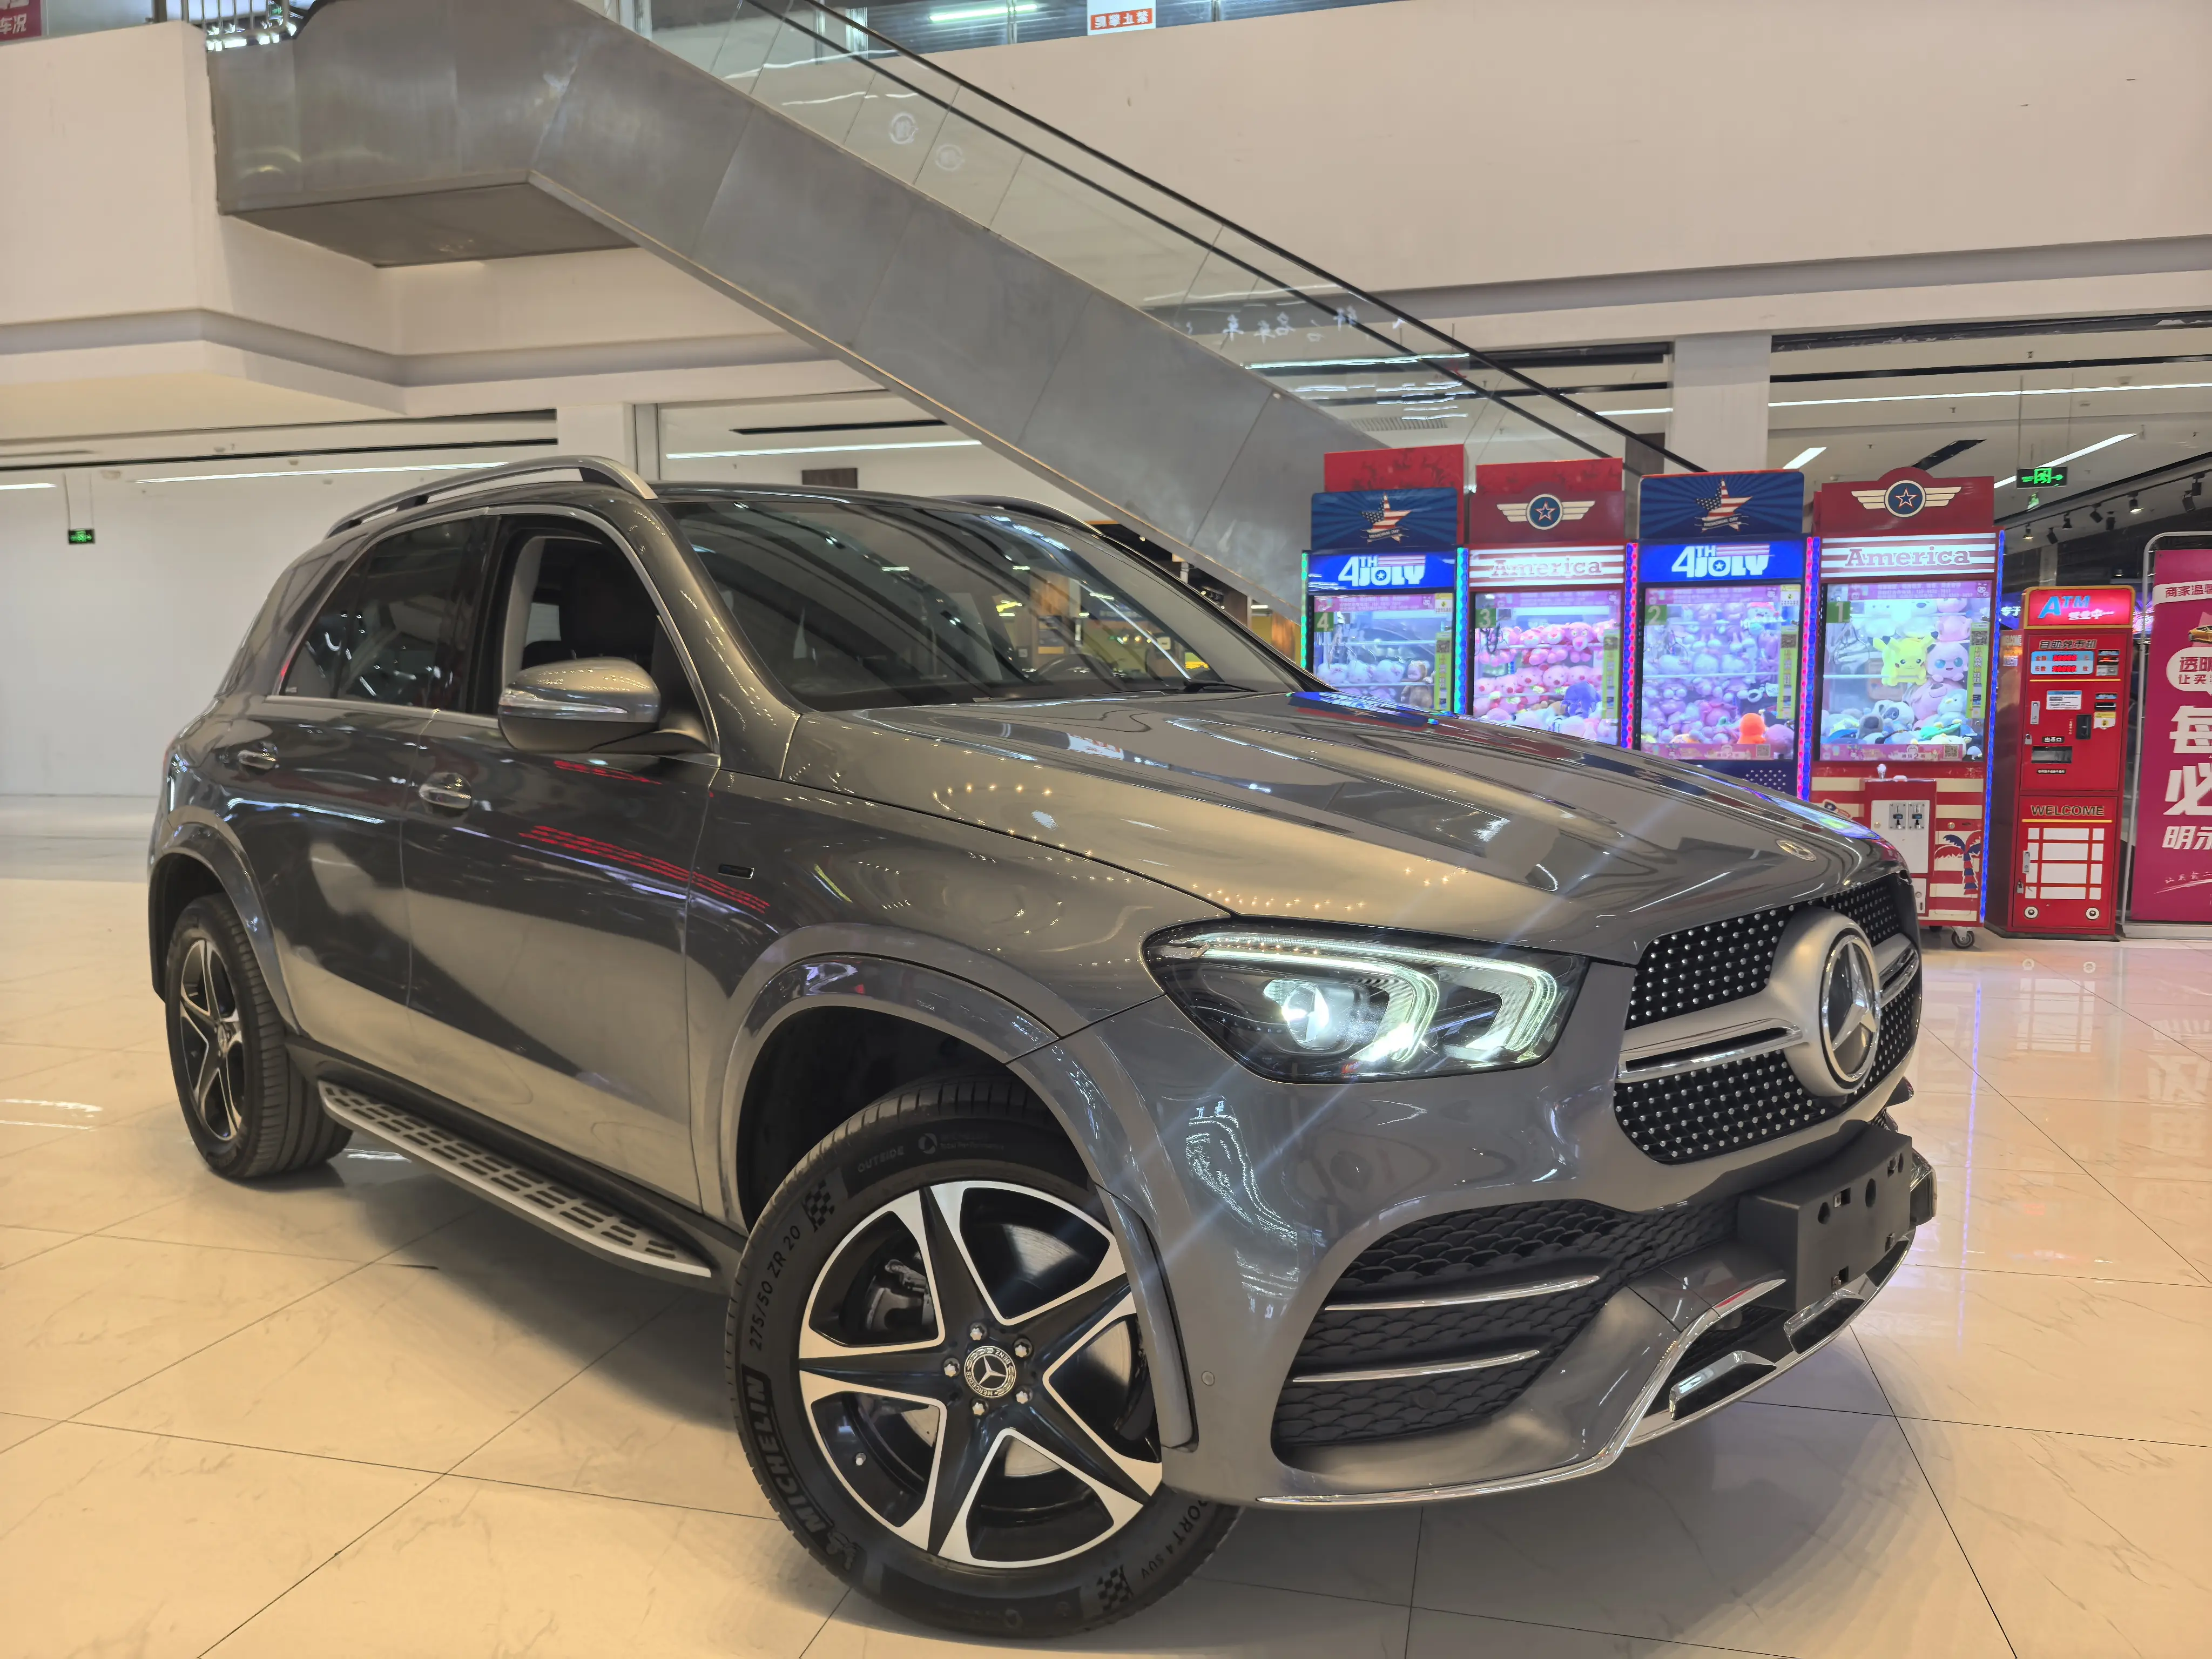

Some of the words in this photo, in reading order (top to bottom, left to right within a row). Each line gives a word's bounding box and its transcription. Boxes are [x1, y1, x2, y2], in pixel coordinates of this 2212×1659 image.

[1845, 546, 1970, 567] America
[1492, 558, 1602, 577] America
[1648, 605, 1661, 625] 2
[1836, 601, 1844, 623] 1
[2038, 595, 2091, 618] ATM
[1317, 612, 1329, 631] 4
[1479, 609, 1492, 628] 3
[2178, 675, 2212, 685] 让买
[2031, 805, 2105, 817] WELCOME
[858, 1145, 906, 1173] OUTSIDE
[749, 1280, 773, 1352] 275/50
[767, 1251, 787, 1279] ZR
[784, 1225, 800, 1251] 20
[995, 1349, 1011, 1365] BENZ
[966, 1371, 994, 1397] MERCEDES
[746, 1375, 828, 1533] MICHELIN
[1141, 1554, 1164, 1579] SUV
